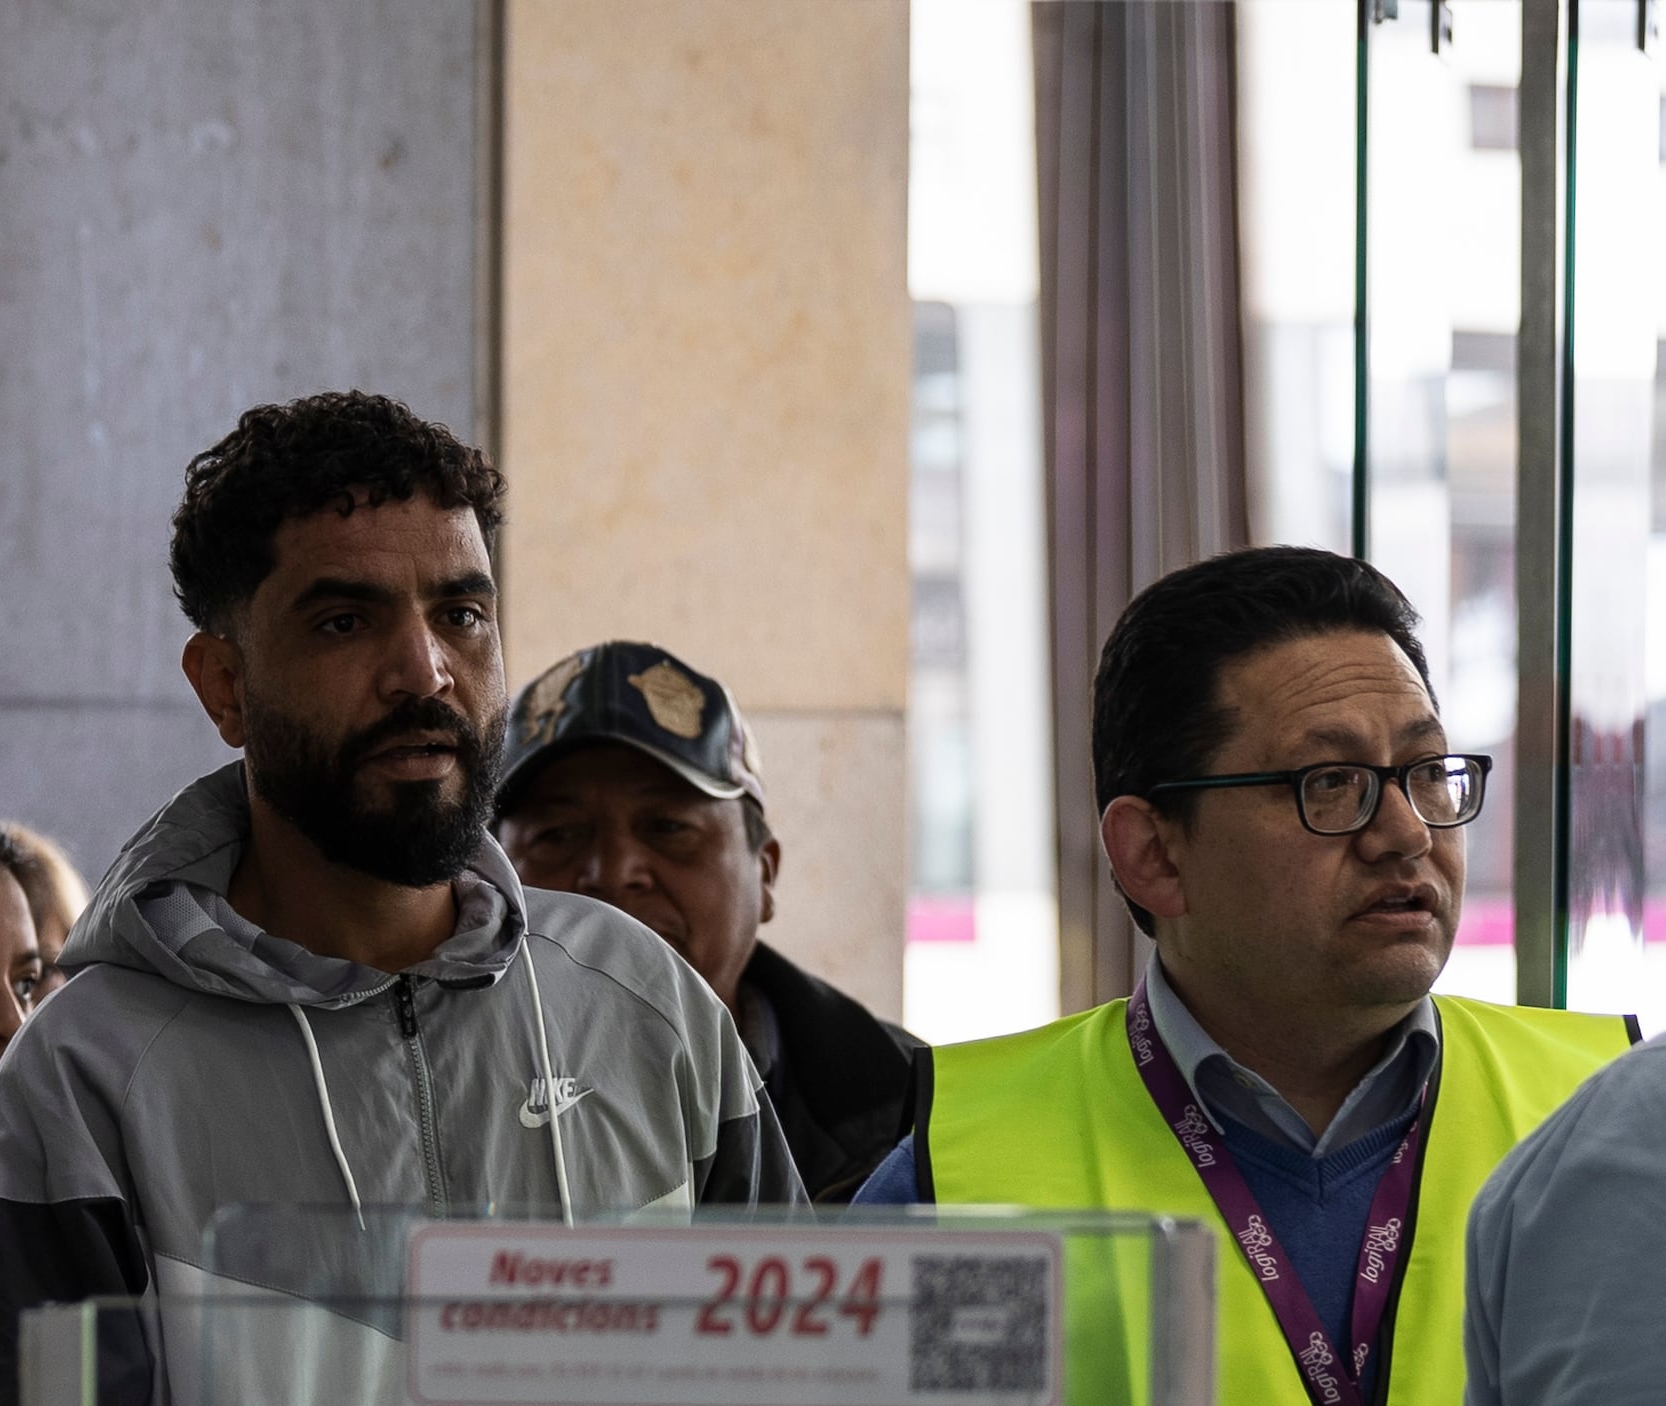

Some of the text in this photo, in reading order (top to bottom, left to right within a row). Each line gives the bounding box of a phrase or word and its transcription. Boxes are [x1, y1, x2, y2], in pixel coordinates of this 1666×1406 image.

[489, 1248, 615, 1289] Noves
[1360, 1225, 1390, 1283] logiRAIL
[439, 1296, 662, 1335] condicions
[695, 1254, 884, 1337] 2024
